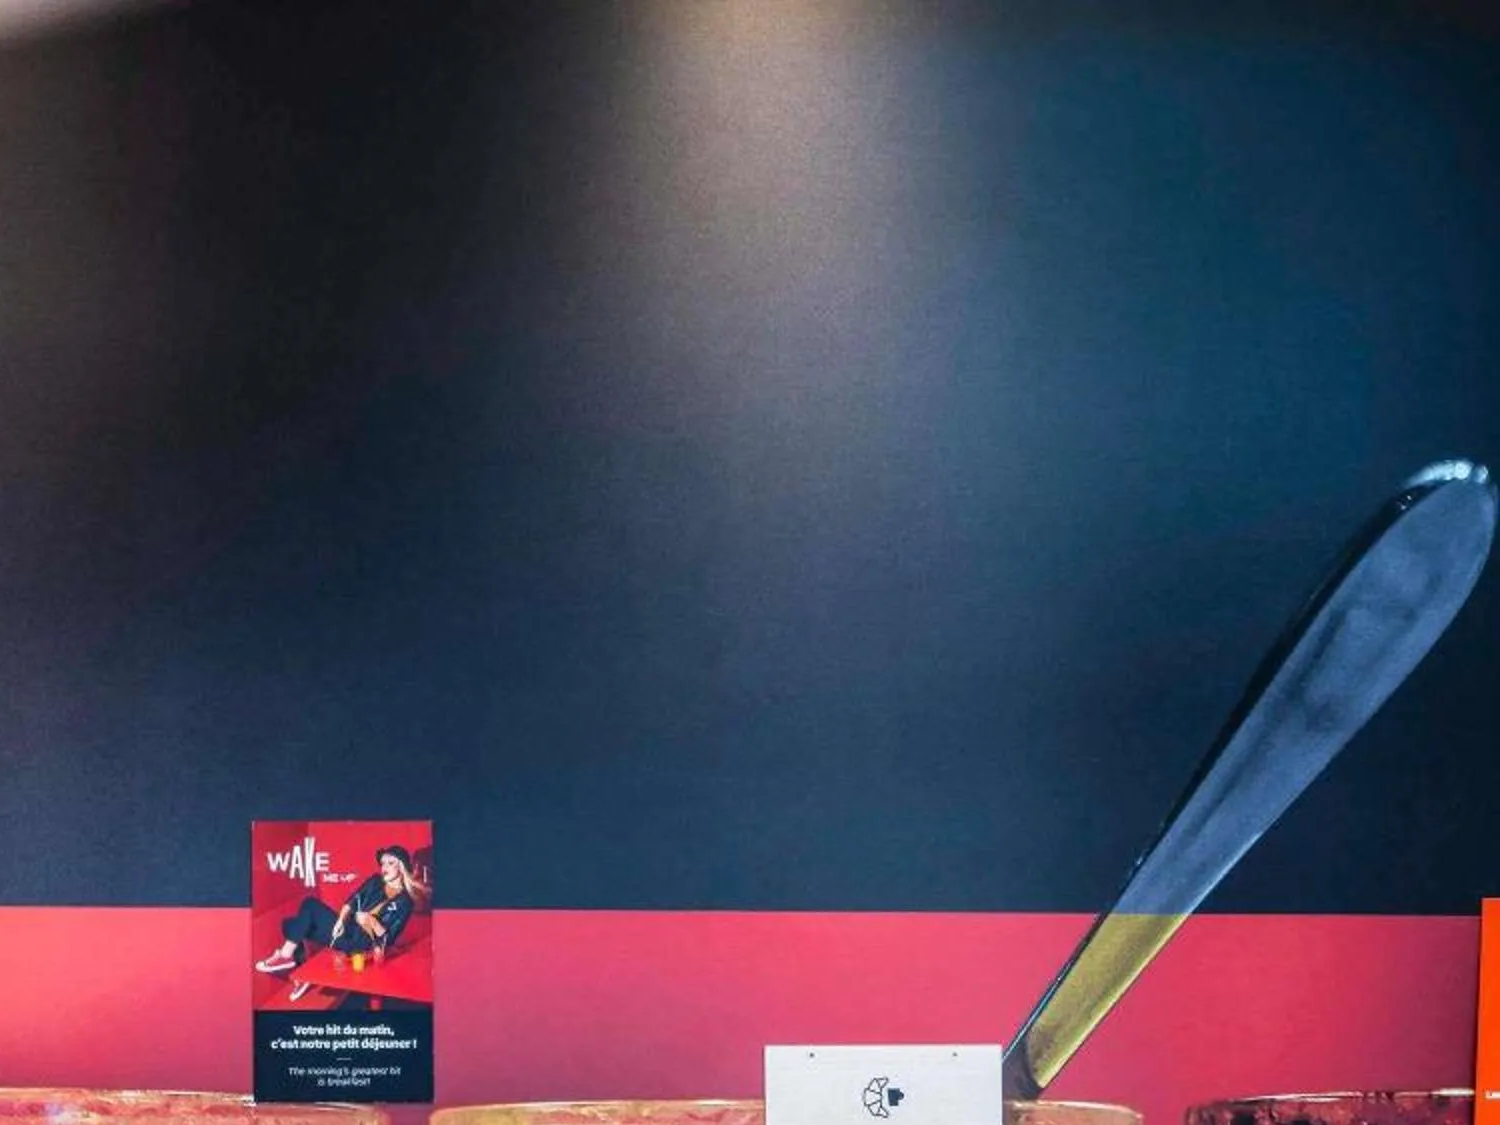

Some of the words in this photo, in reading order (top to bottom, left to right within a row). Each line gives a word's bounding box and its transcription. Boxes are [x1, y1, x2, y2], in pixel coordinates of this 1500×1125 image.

[267, 836, 330, 888] WAKE
[293, 1025, 324, 1036] Votre
[326, 1024, 341, 1035] hit
[343, 1024, 357, 1035] du
[359, 1024, 395, 1037] matin,
[300, 1039, 331, 1049] notre
[332, 1038, 359, 1051] petit
[361, 1037, 411, 1051] déjeuner
